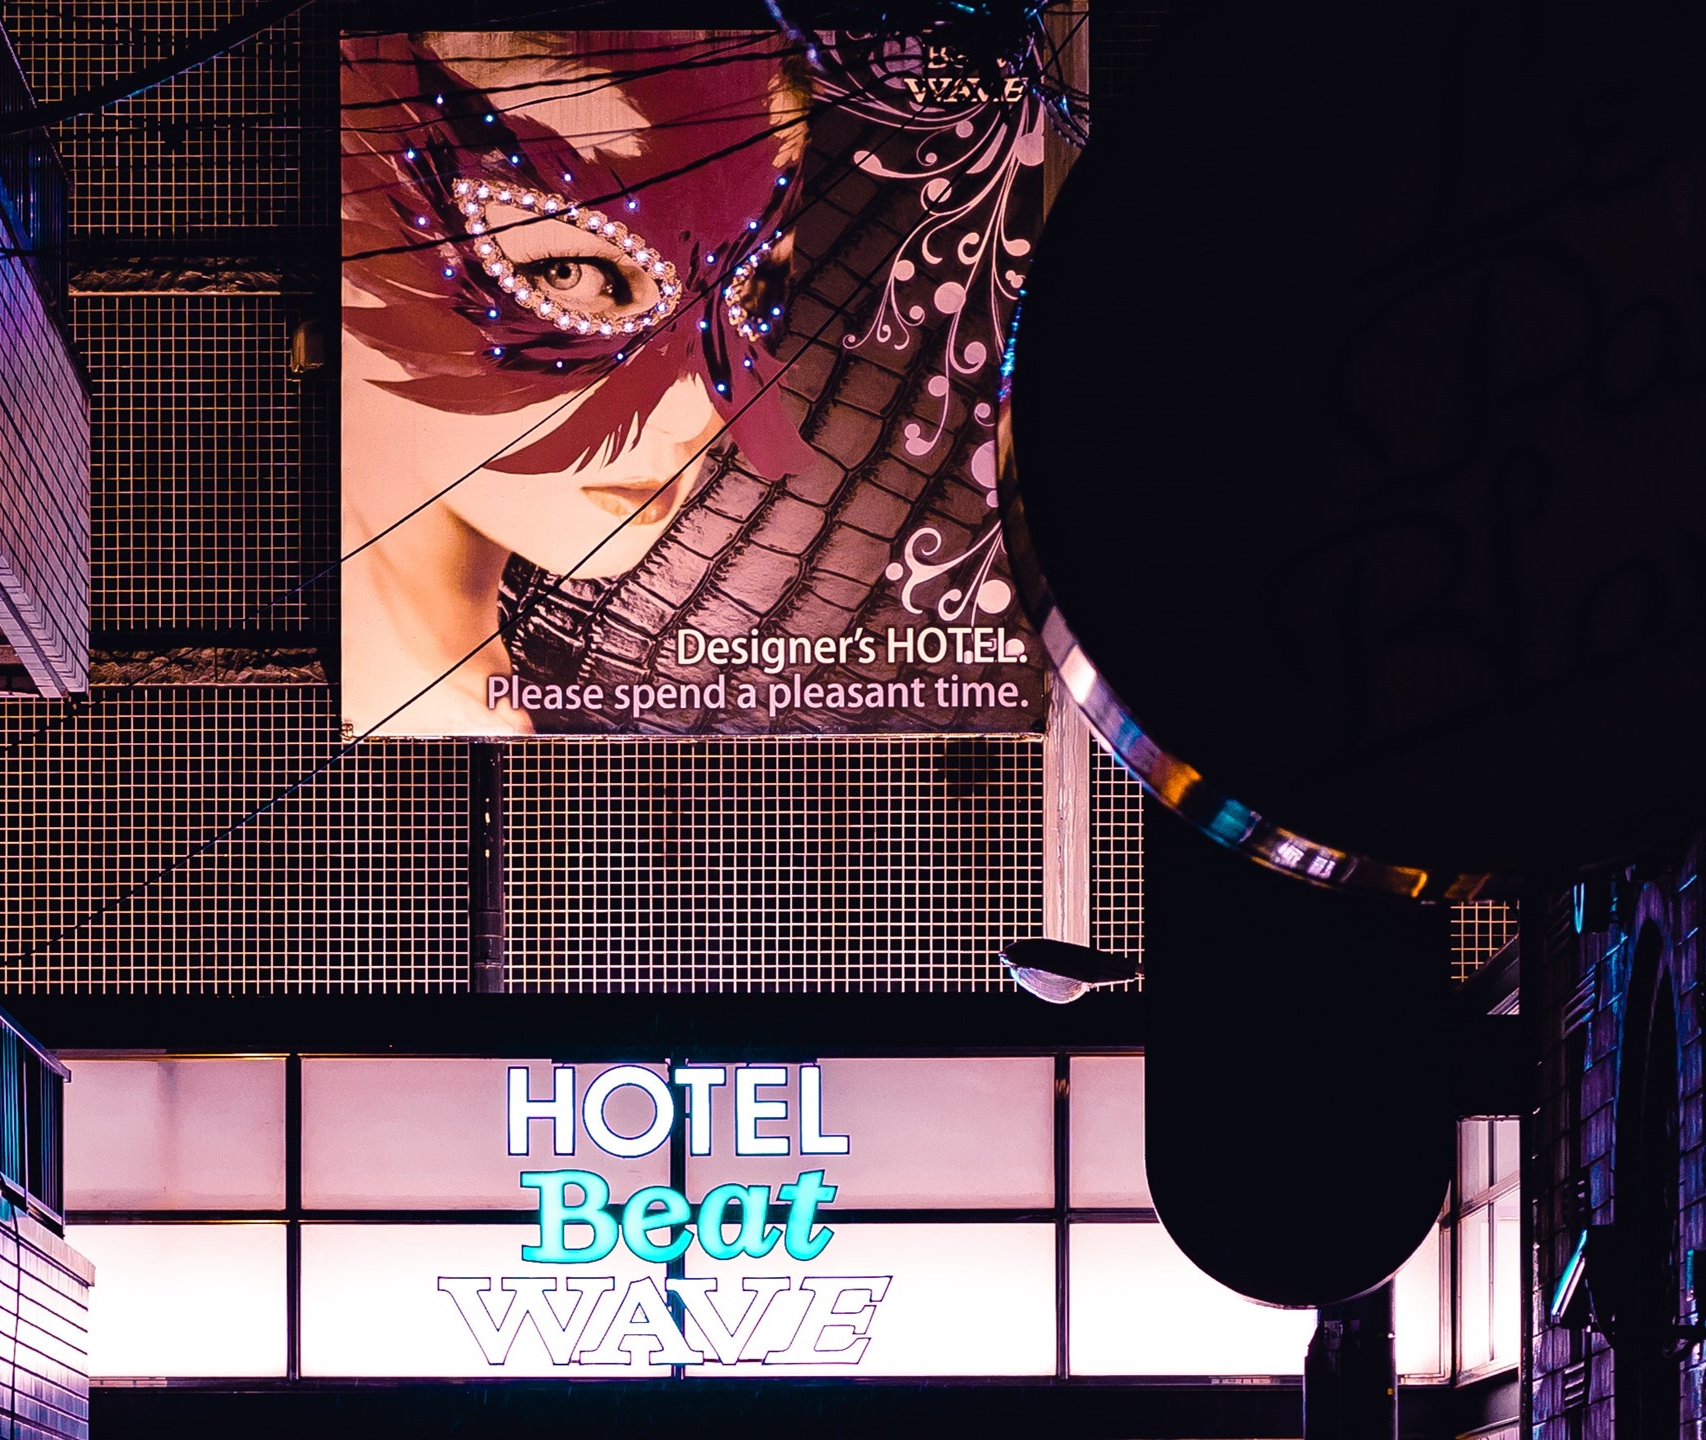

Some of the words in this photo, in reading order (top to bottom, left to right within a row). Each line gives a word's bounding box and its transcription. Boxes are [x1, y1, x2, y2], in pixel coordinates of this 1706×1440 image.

[677, 628, 876, 674] Designer's
[887, 627, 1028, 664] HOTEL.
[488, 676, 604, 710] Please
[615, 676, 726, 717] spend
[738, 685, 757, 709] a
[769, 676, 926, 717] pleasant
[935, 676, 1029, 709] time.
[507, 1065, 850, 1158] HOTEL
[520, 1169, 838, 1263] Beat
[437, 1275, 893, 1366] WAVE
